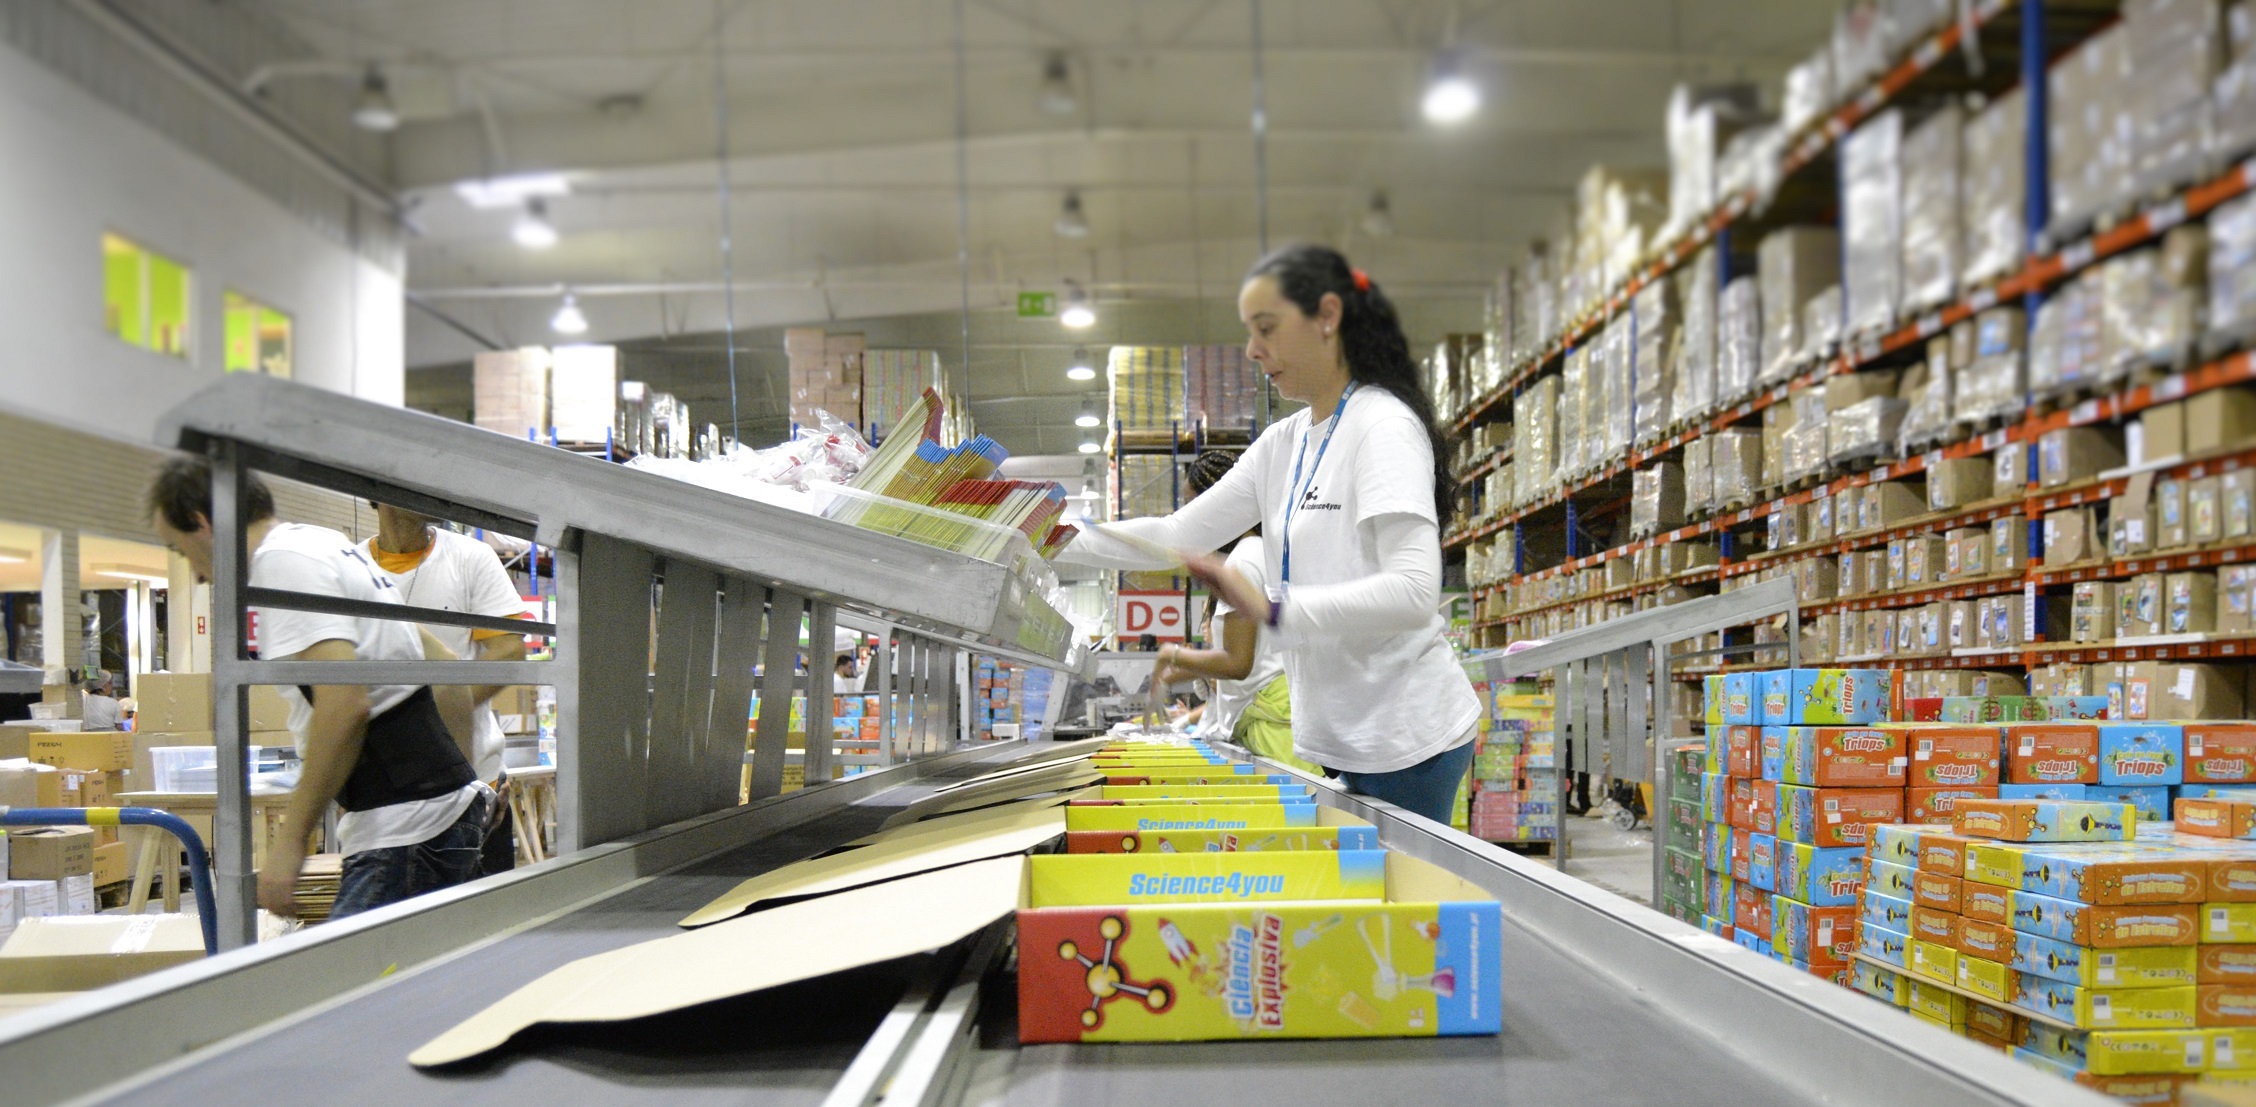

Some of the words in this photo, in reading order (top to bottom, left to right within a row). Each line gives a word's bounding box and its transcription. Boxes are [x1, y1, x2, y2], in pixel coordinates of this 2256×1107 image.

[1127, 601, 1153, 631] D
[1843, 675, 1855, 715] Triops
[1843, 737, 1886, 752] Triops
[1935, 763, 1977, 778] Triops
[2037, 760, 2077, 774] Triops
[2115, 761, 2165, 777] Triops
[2204, 758, 2244, 774] Triops
[1129, 872, 1285, 897] Science4you
[2137, 881, 2186, 895] Estrellas
[1257, 914, 1282, 1026] Explosiva
